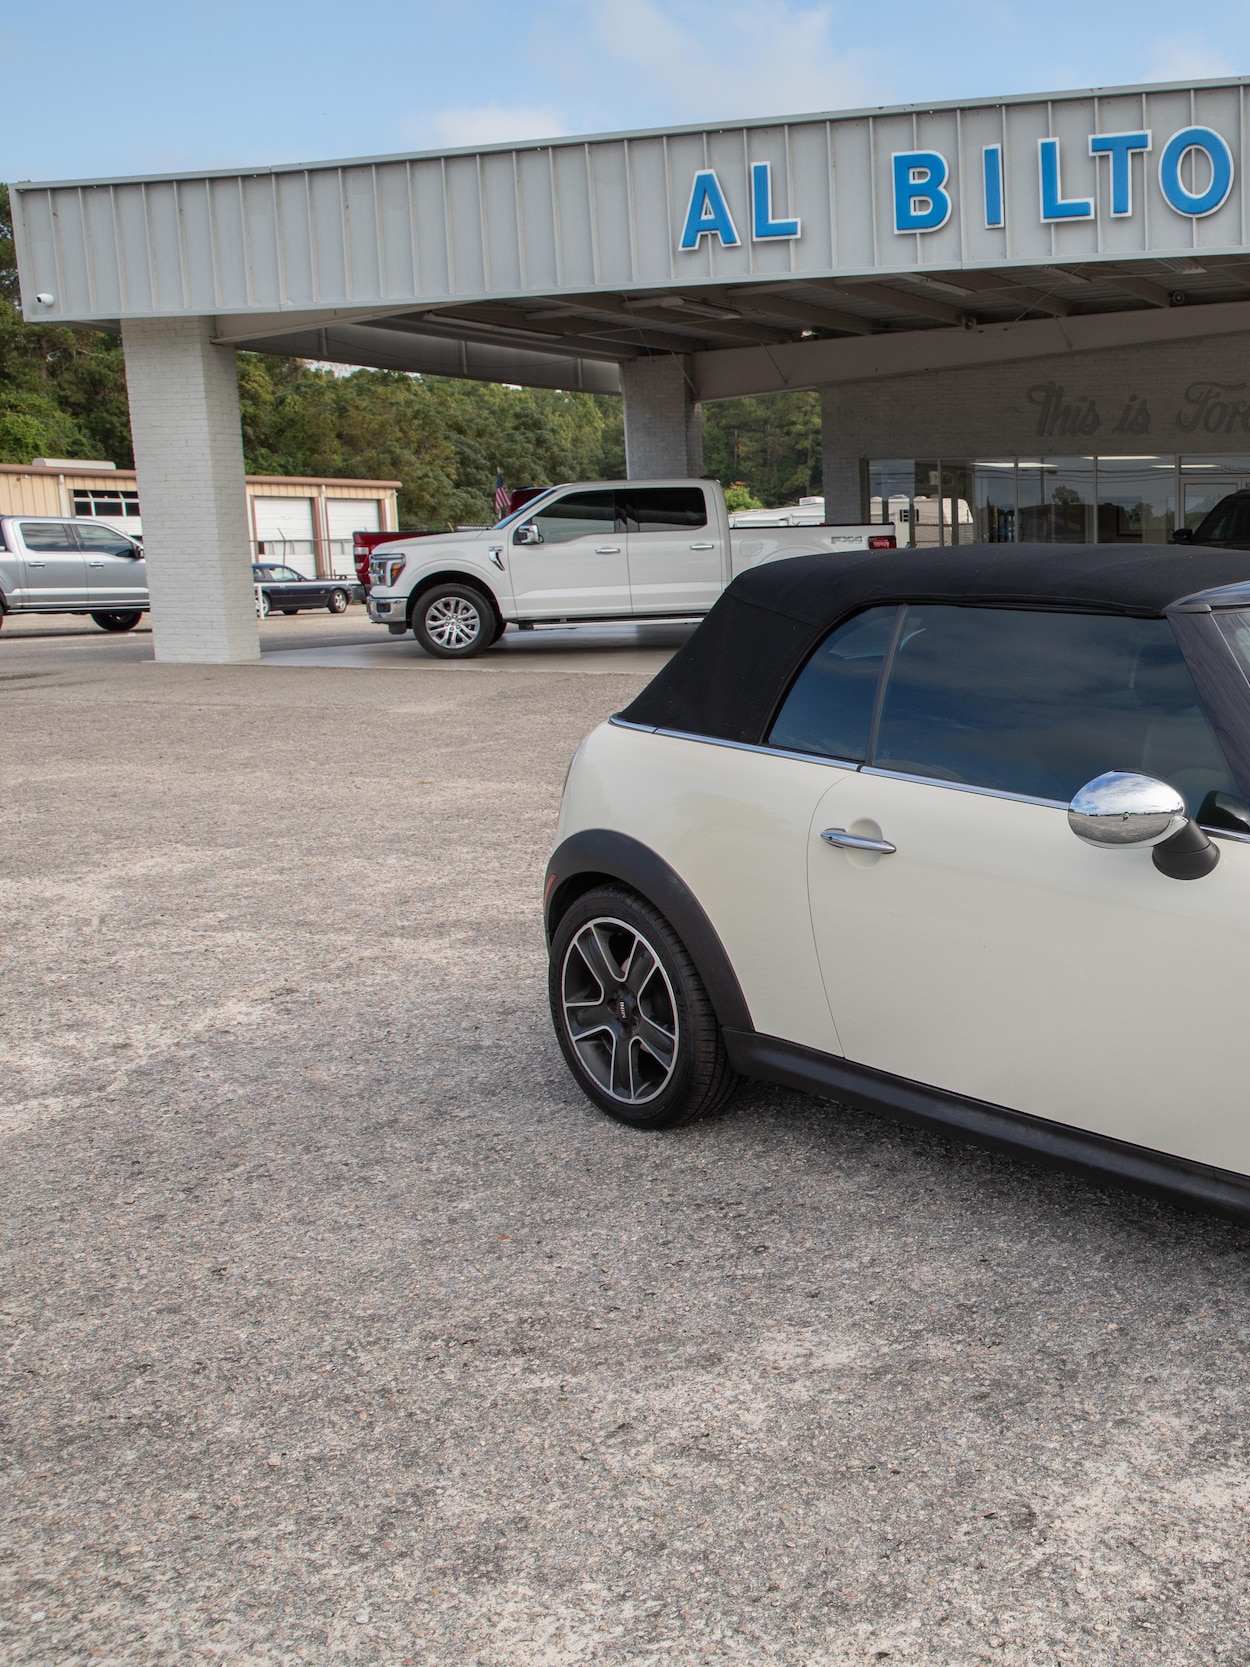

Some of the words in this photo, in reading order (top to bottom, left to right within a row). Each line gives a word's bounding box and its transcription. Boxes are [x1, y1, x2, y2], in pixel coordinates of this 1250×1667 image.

[678, 160, 801, 252] AL
[1026, 380, 1102, 437] This
[1113, 394, 1151, 436] is
[830, 535, 863, 545] FX4
[619, 1001, 627, 1019] MINI
